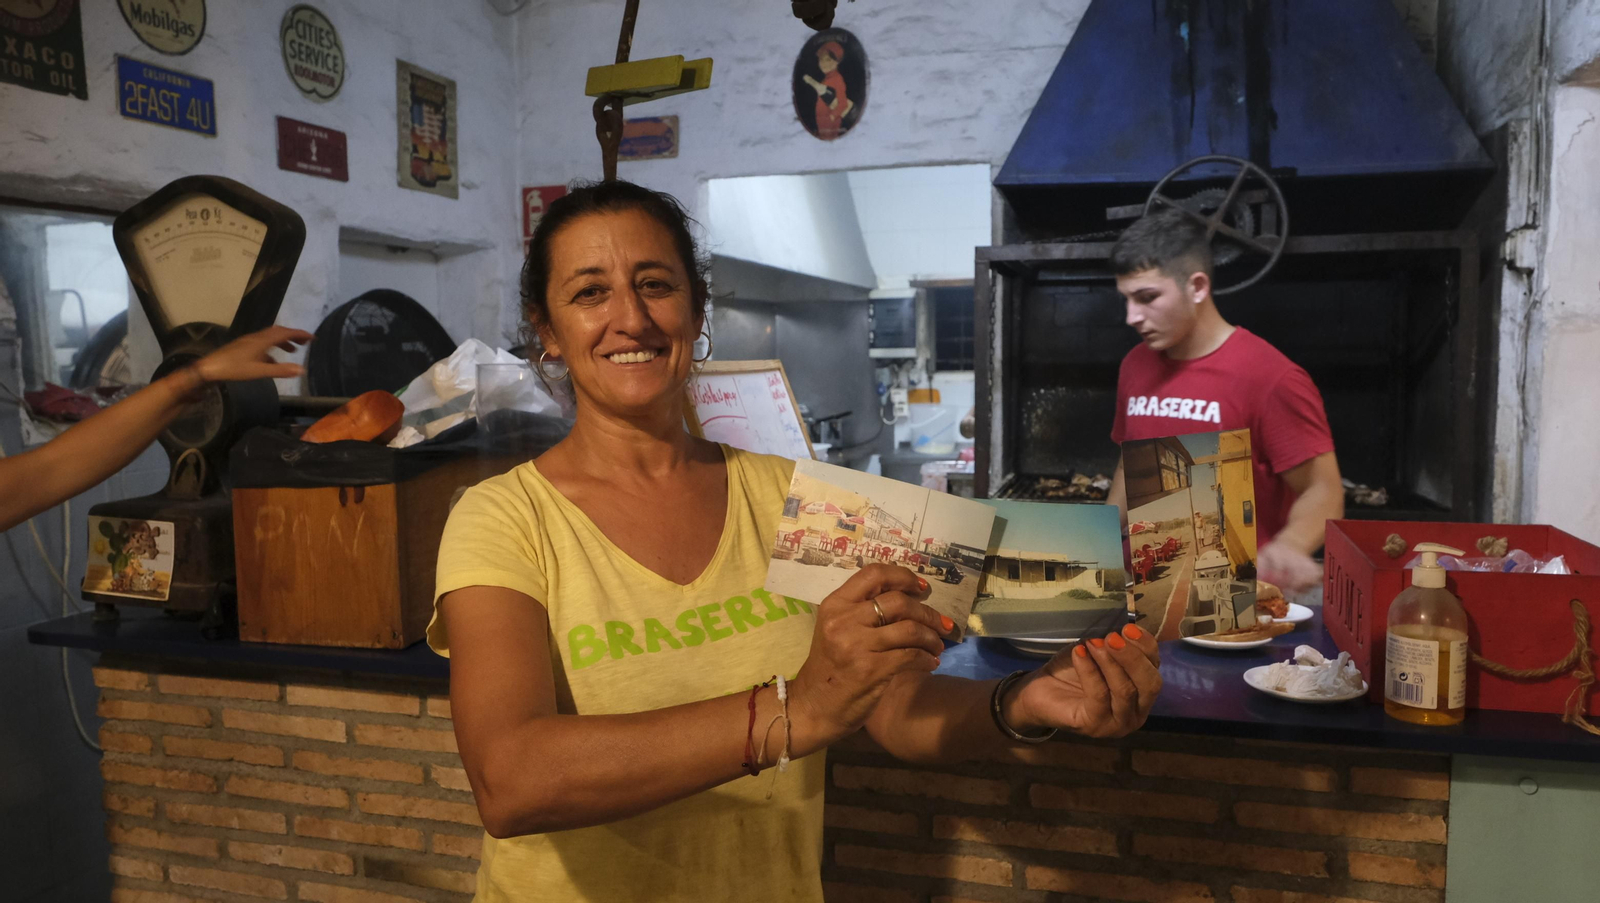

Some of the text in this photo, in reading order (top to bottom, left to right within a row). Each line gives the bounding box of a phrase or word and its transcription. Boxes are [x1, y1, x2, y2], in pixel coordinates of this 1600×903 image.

[130, 1, 196, 38] Mobilgas
[295, 19, 334, 50] CITIES
[288, 40, 339, 74] SERVICE
[49, 70, 77, 90] OIL
[125, 81, 210, 130] 2FAST 4U
[1127, 395, 1221, 424] BRASERIA
[1327, 551, 1364, 645] HOME
